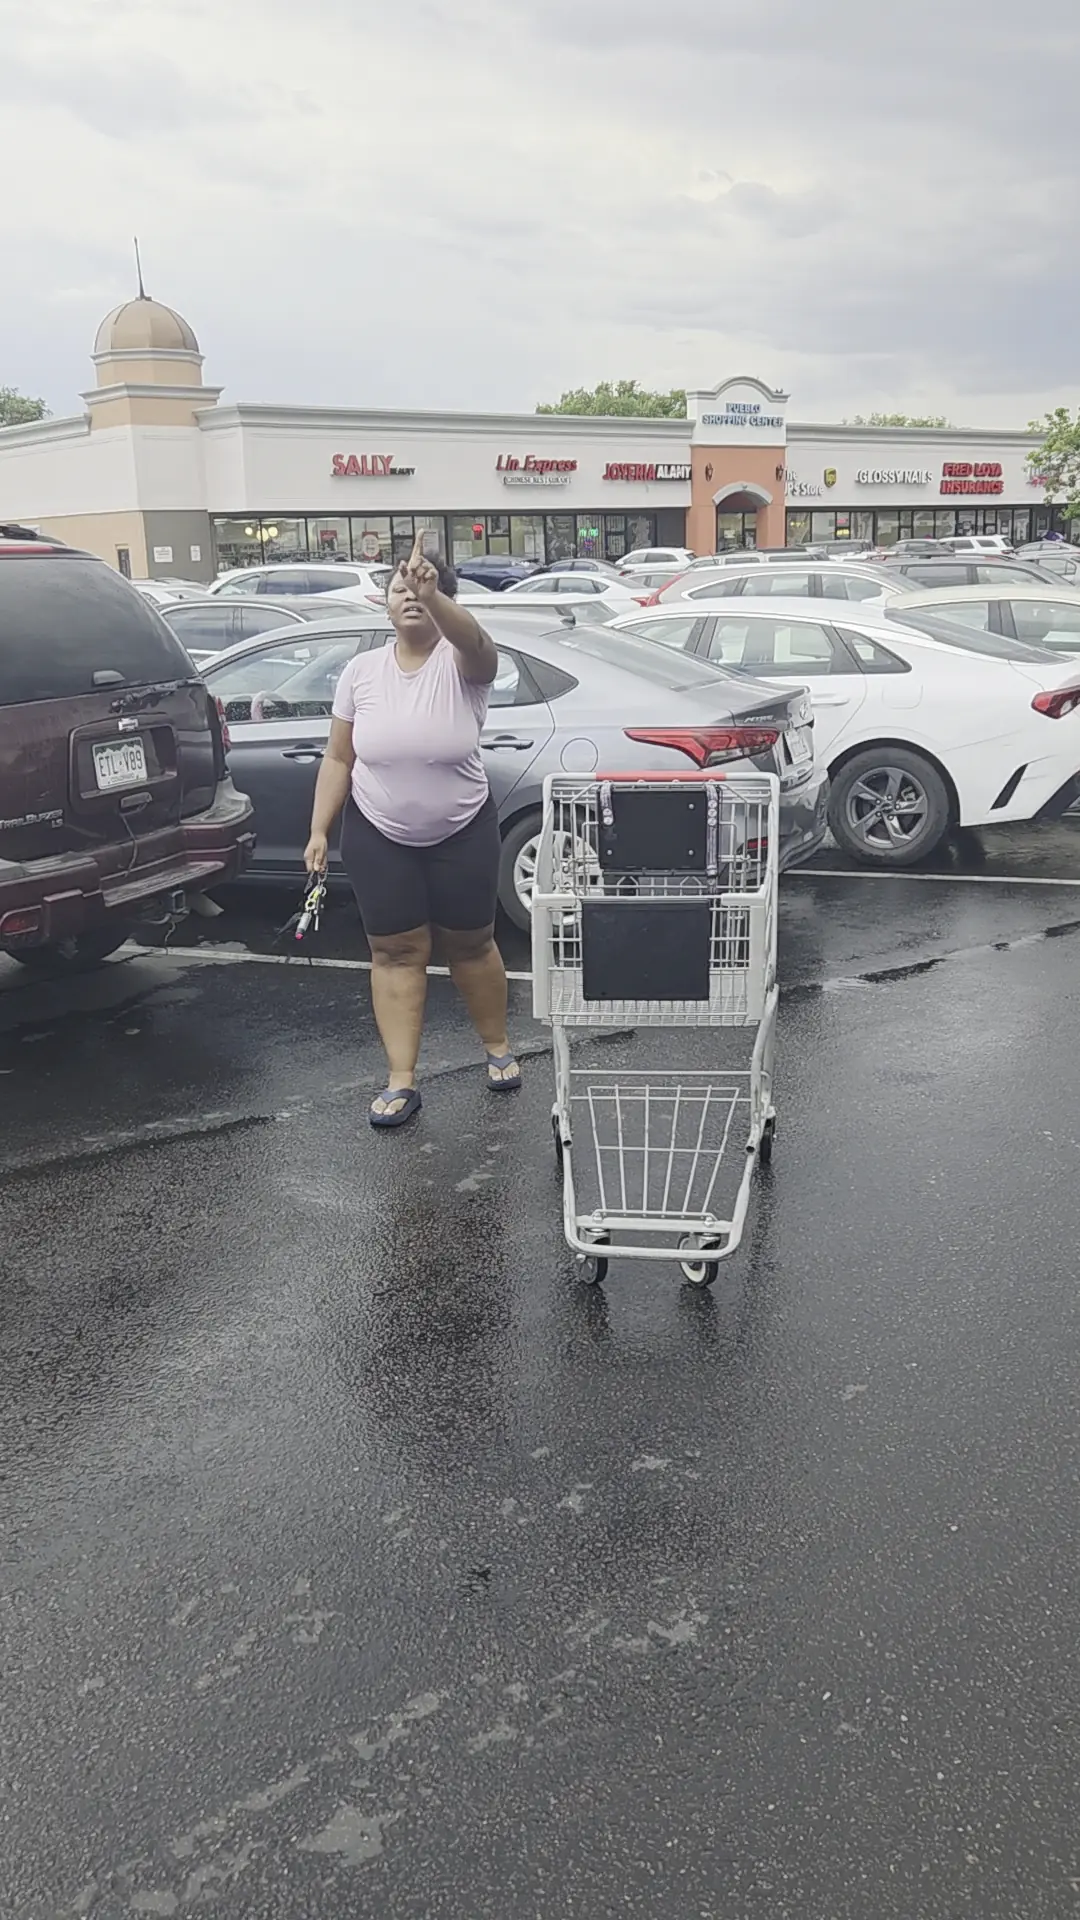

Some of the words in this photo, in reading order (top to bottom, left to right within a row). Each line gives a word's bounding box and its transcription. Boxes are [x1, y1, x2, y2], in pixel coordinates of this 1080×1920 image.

[726, 403, 760, 414] PUEBLO
[702, 414, 747, 426] SHOPPING
[748, 416, 784, 427] CENTER
[332, 453, 394, 476] SALLY
[523, 454, 578, 474] Express
[602, 462, 656, 481] JOYERIA
[942, 462, 972, 477] FRED
[973, 462, 1002, 477] LOYA
[902, 469, 932, 484] NAILS
[800, 483, 824, 497] Store
[939, 479, 1004, 495] INSURANCE
[51, 818, 63, 829] LS
